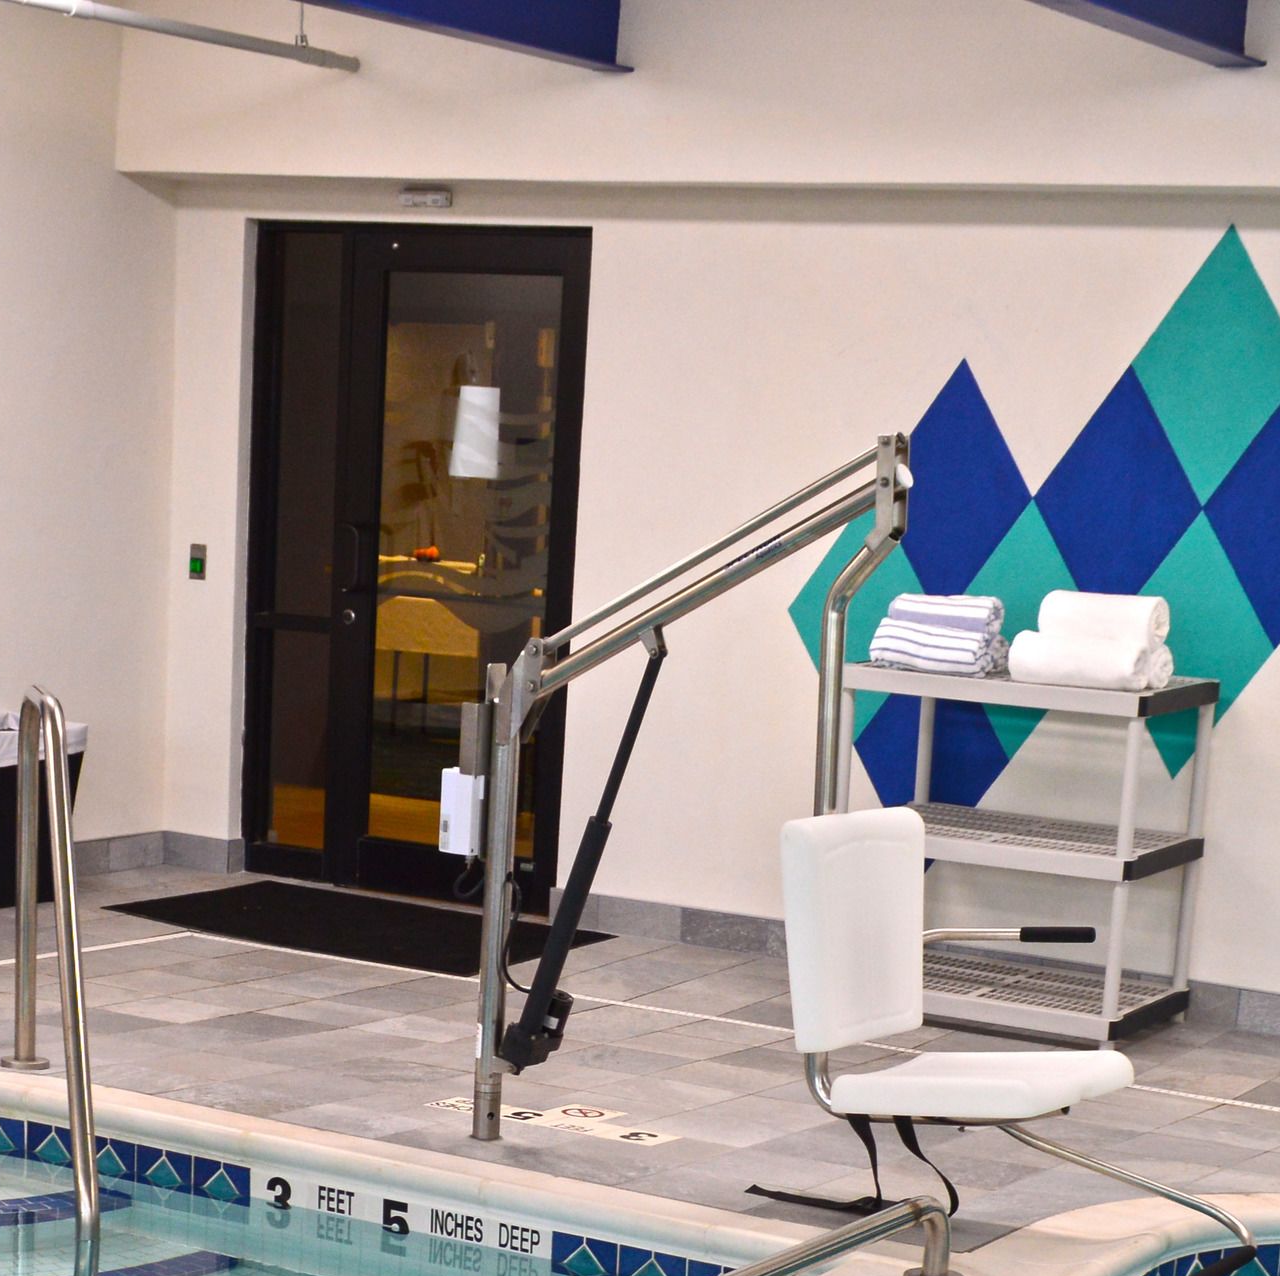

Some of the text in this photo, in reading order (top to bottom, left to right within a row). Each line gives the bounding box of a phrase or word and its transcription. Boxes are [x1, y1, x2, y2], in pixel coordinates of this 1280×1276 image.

[619, 1131, 659, 1141] 3
[266, 1176, 541, 1254] 3 FEET 5 INCHES DEEP
